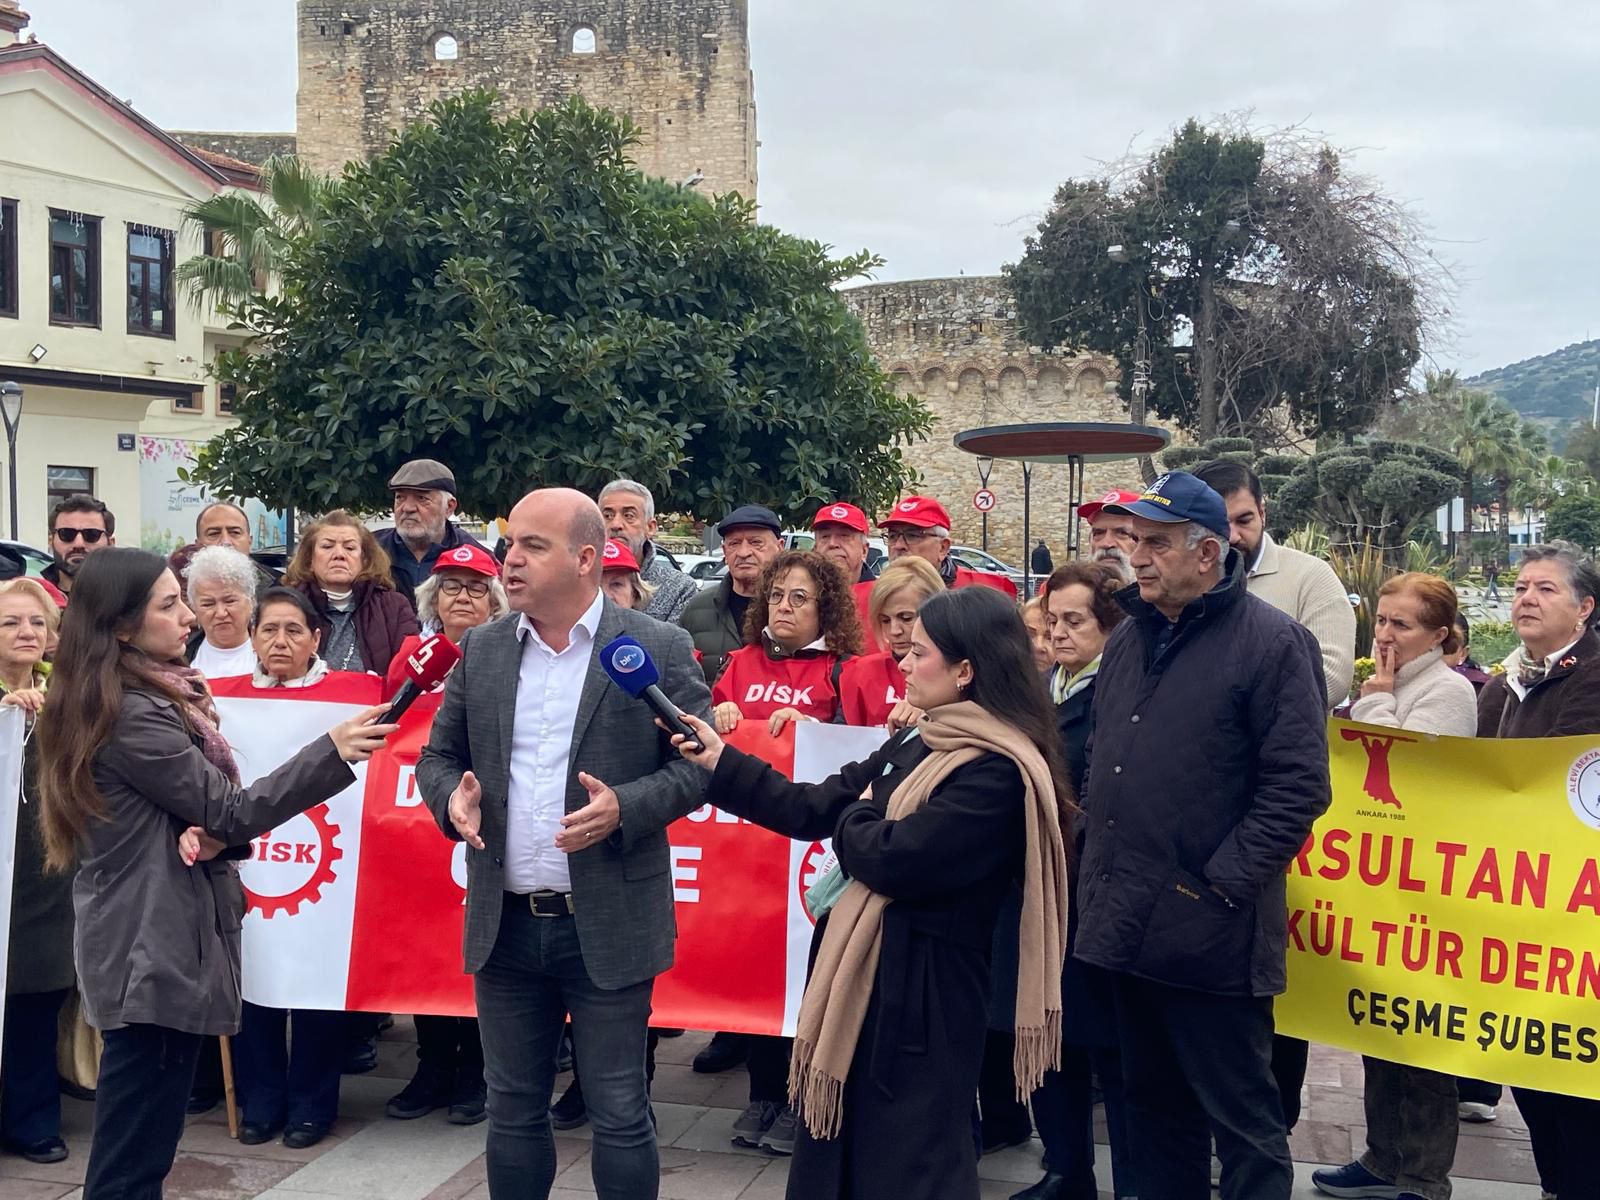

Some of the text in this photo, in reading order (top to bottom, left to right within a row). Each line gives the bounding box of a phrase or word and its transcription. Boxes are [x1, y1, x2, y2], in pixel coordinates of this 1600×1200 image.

[744, 680, 815, 706] DİSK
[1356, 809, 1388, 819] ANKARA
[249, 830, 317, 864] İSK
[1347, 988, 1599, 1064] ÇEŞME ŞUBES
